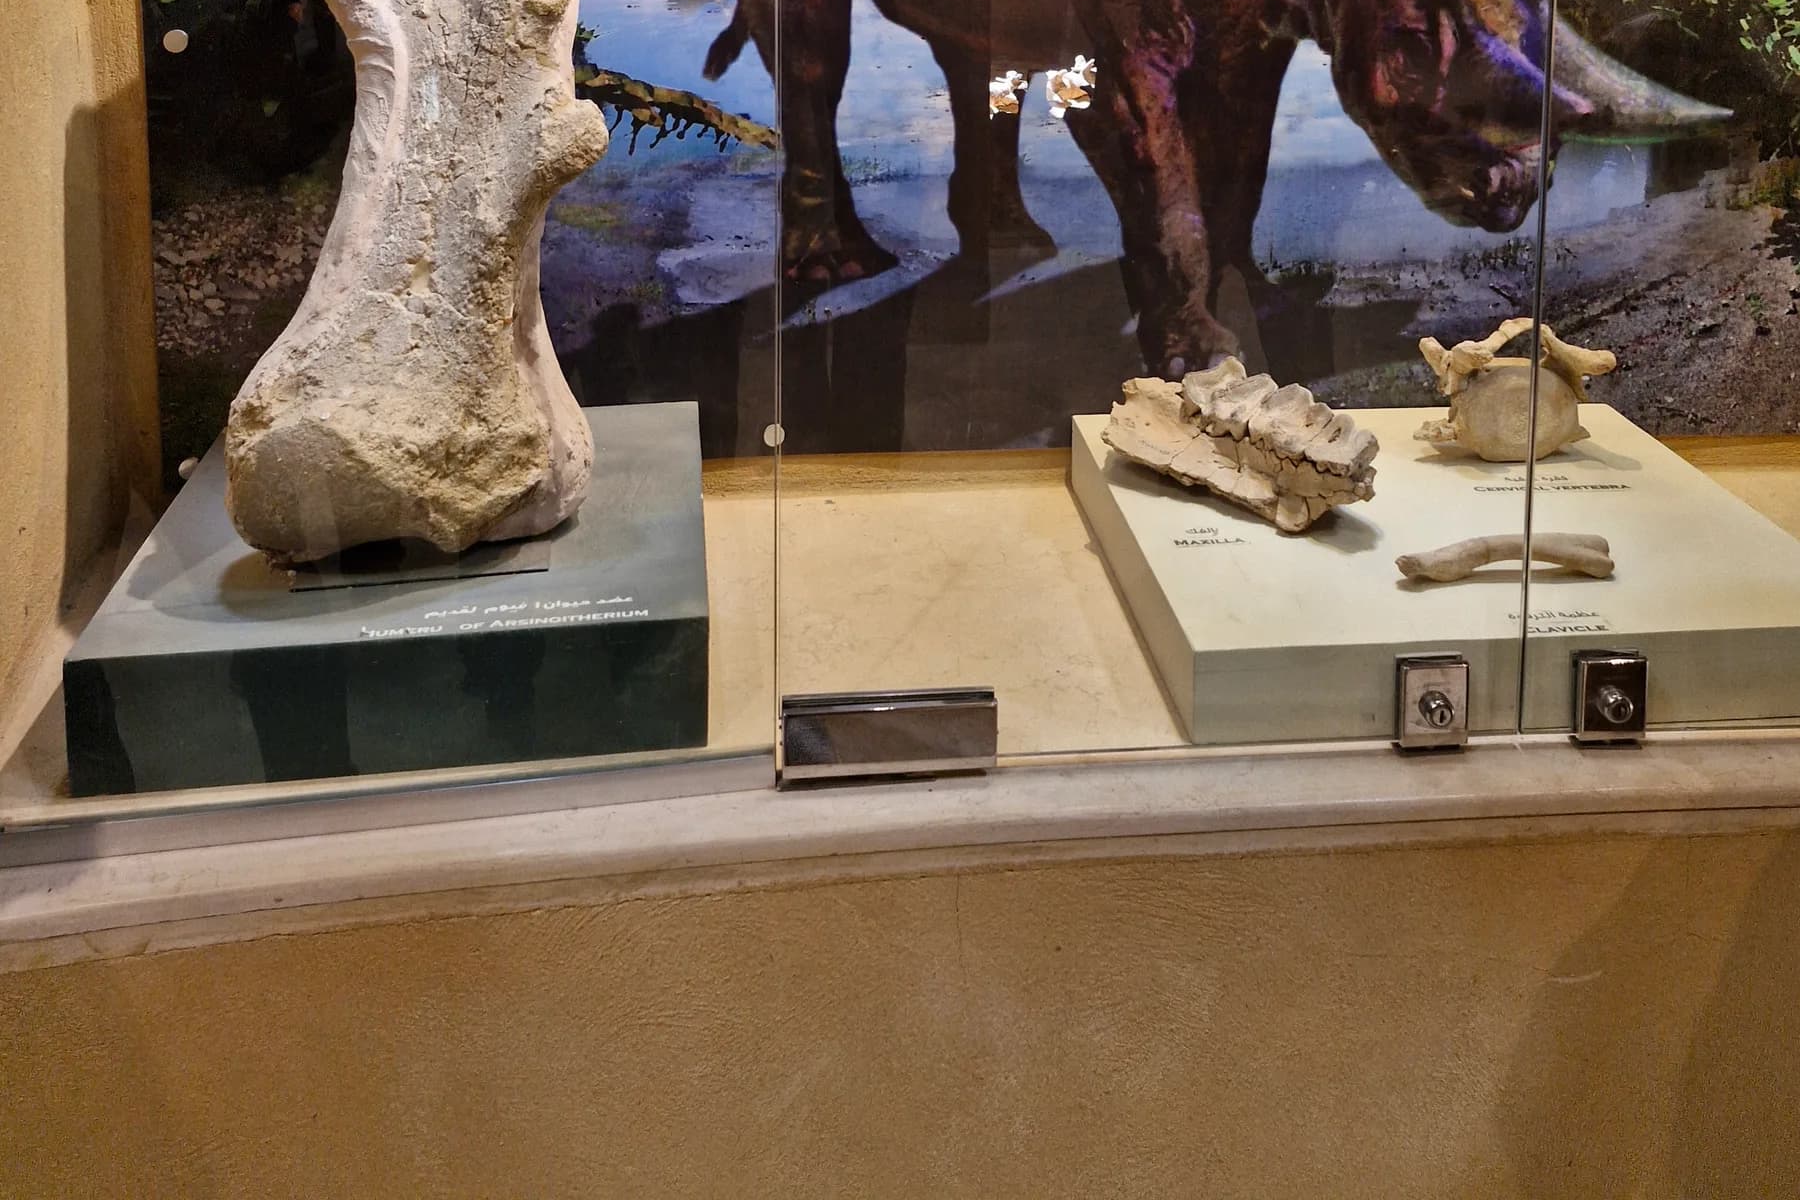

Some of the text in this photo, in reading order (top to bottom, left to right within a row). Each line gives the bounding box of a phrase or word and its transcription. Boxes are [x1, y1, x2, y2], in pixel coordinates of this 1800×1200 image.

[1551, 484, 1632, 492] VERTEBRA
[1173, 538, 1246, 546] MAXILLA
[459, 621, 486, 631] OF
[489, 610, 649, 628] ARSINOITHERIUM
